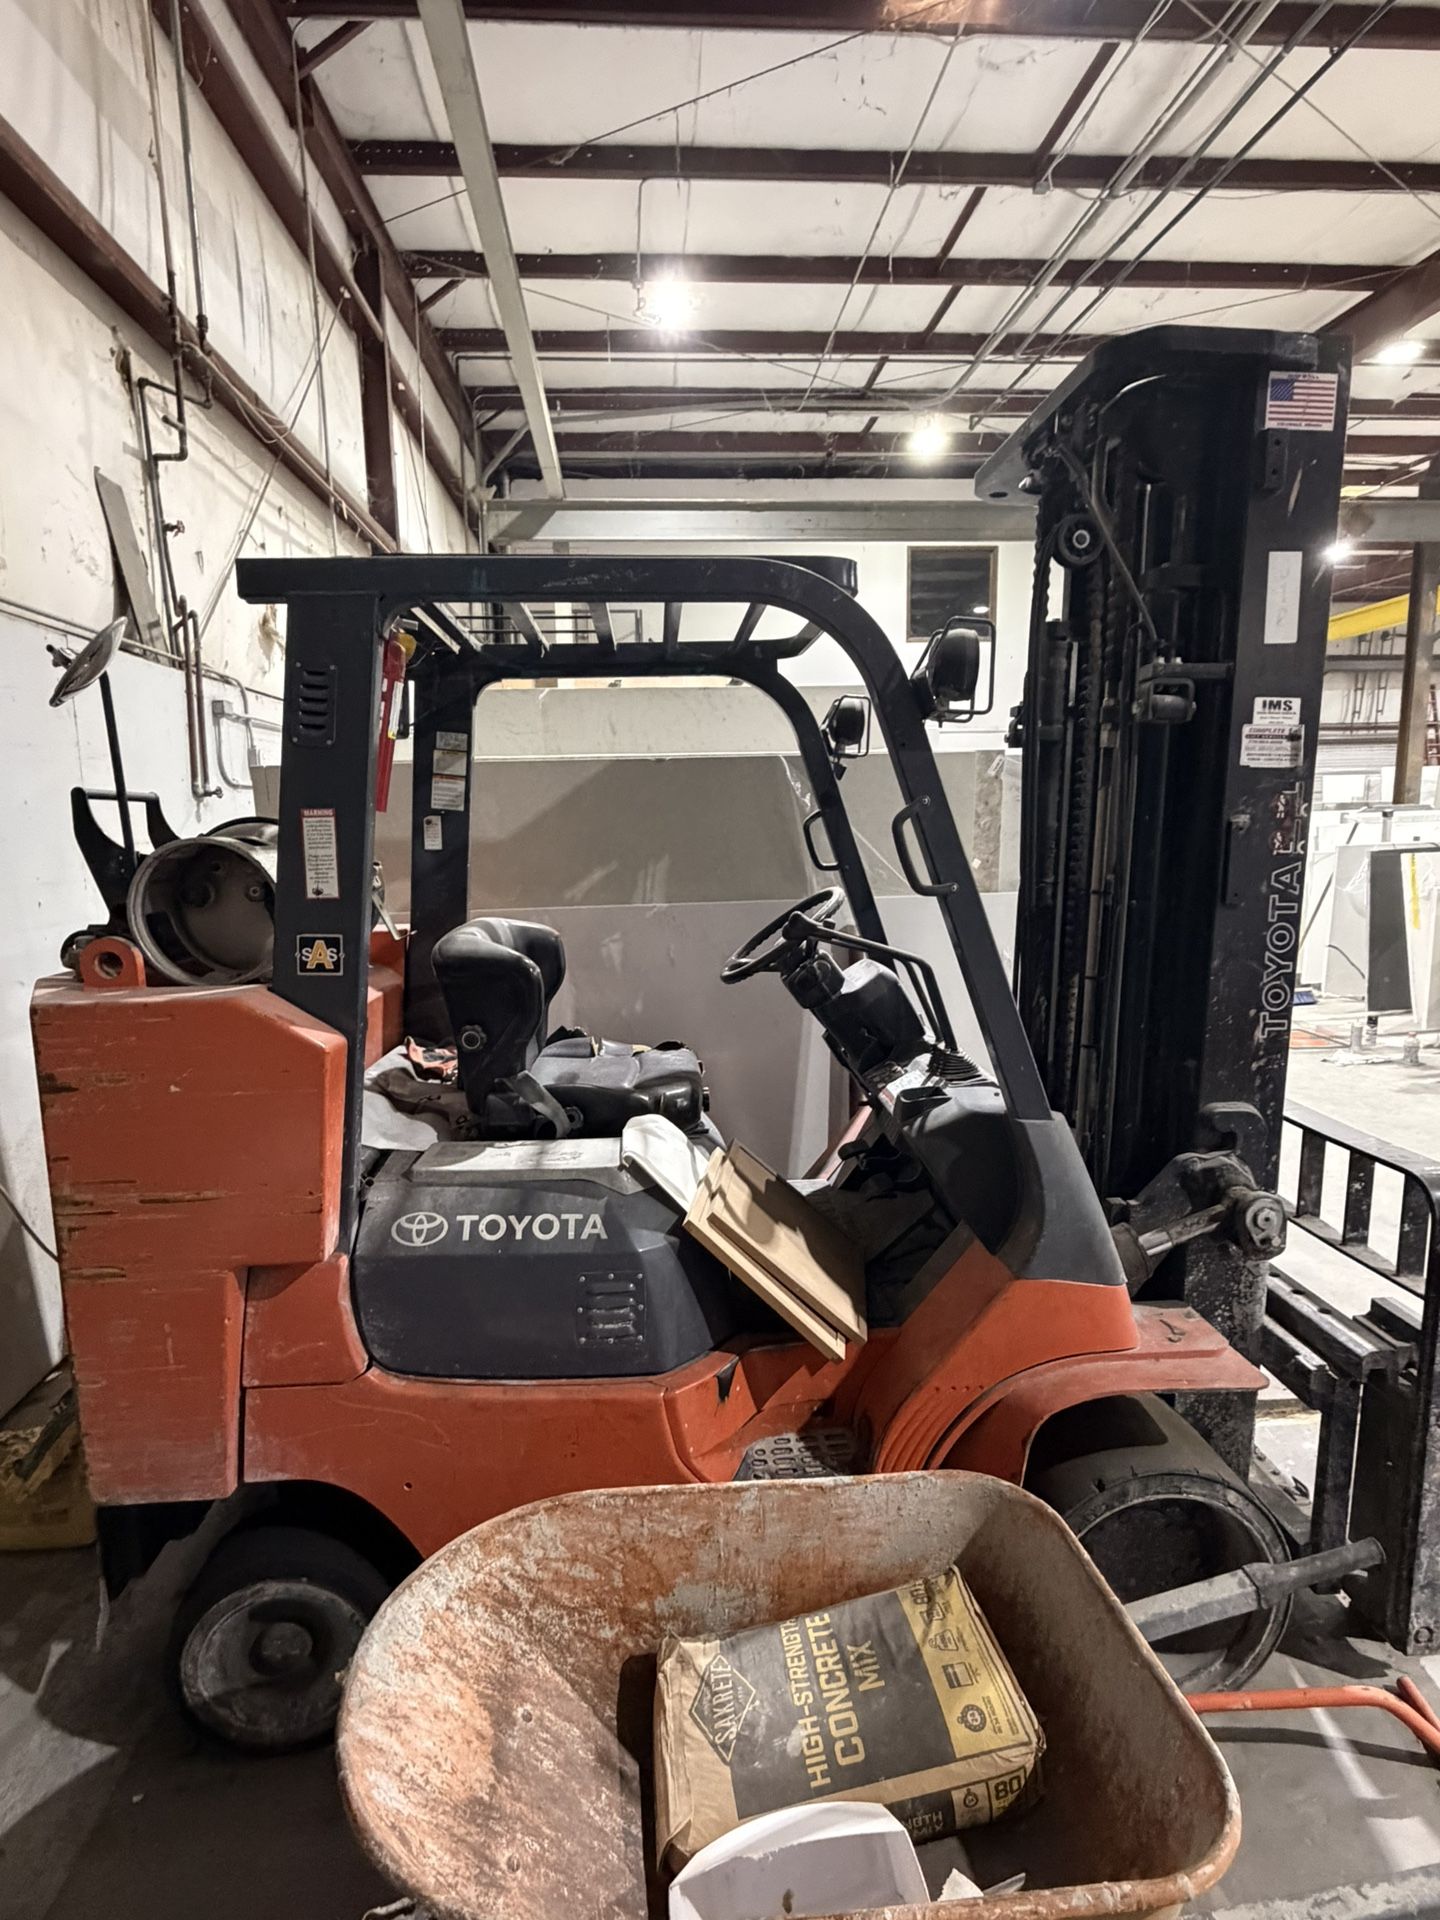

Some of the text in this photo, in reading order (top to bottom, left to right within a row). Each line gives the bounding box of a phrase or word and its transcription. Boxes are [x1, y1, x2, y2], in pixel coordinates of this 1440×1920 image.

[1262, 699, 1293, 711] IMS
[303, 809, 334, 817] WARNING
[301, 939, 338, 970] SAS
[1259, 861, 1302, 1043] TOYOTA
[456, 1213, 608, 1242] TOYOTA
[847, 1640, 886, 1692] MIX
[711, 1662, 738, 1745] SAKRETE
[779, 1617, 832, 1788] HIGH-STRENGTH
[805, 1613, 866, 1767] CONCRETE
[994, 1775, 1022, 1801] 80
